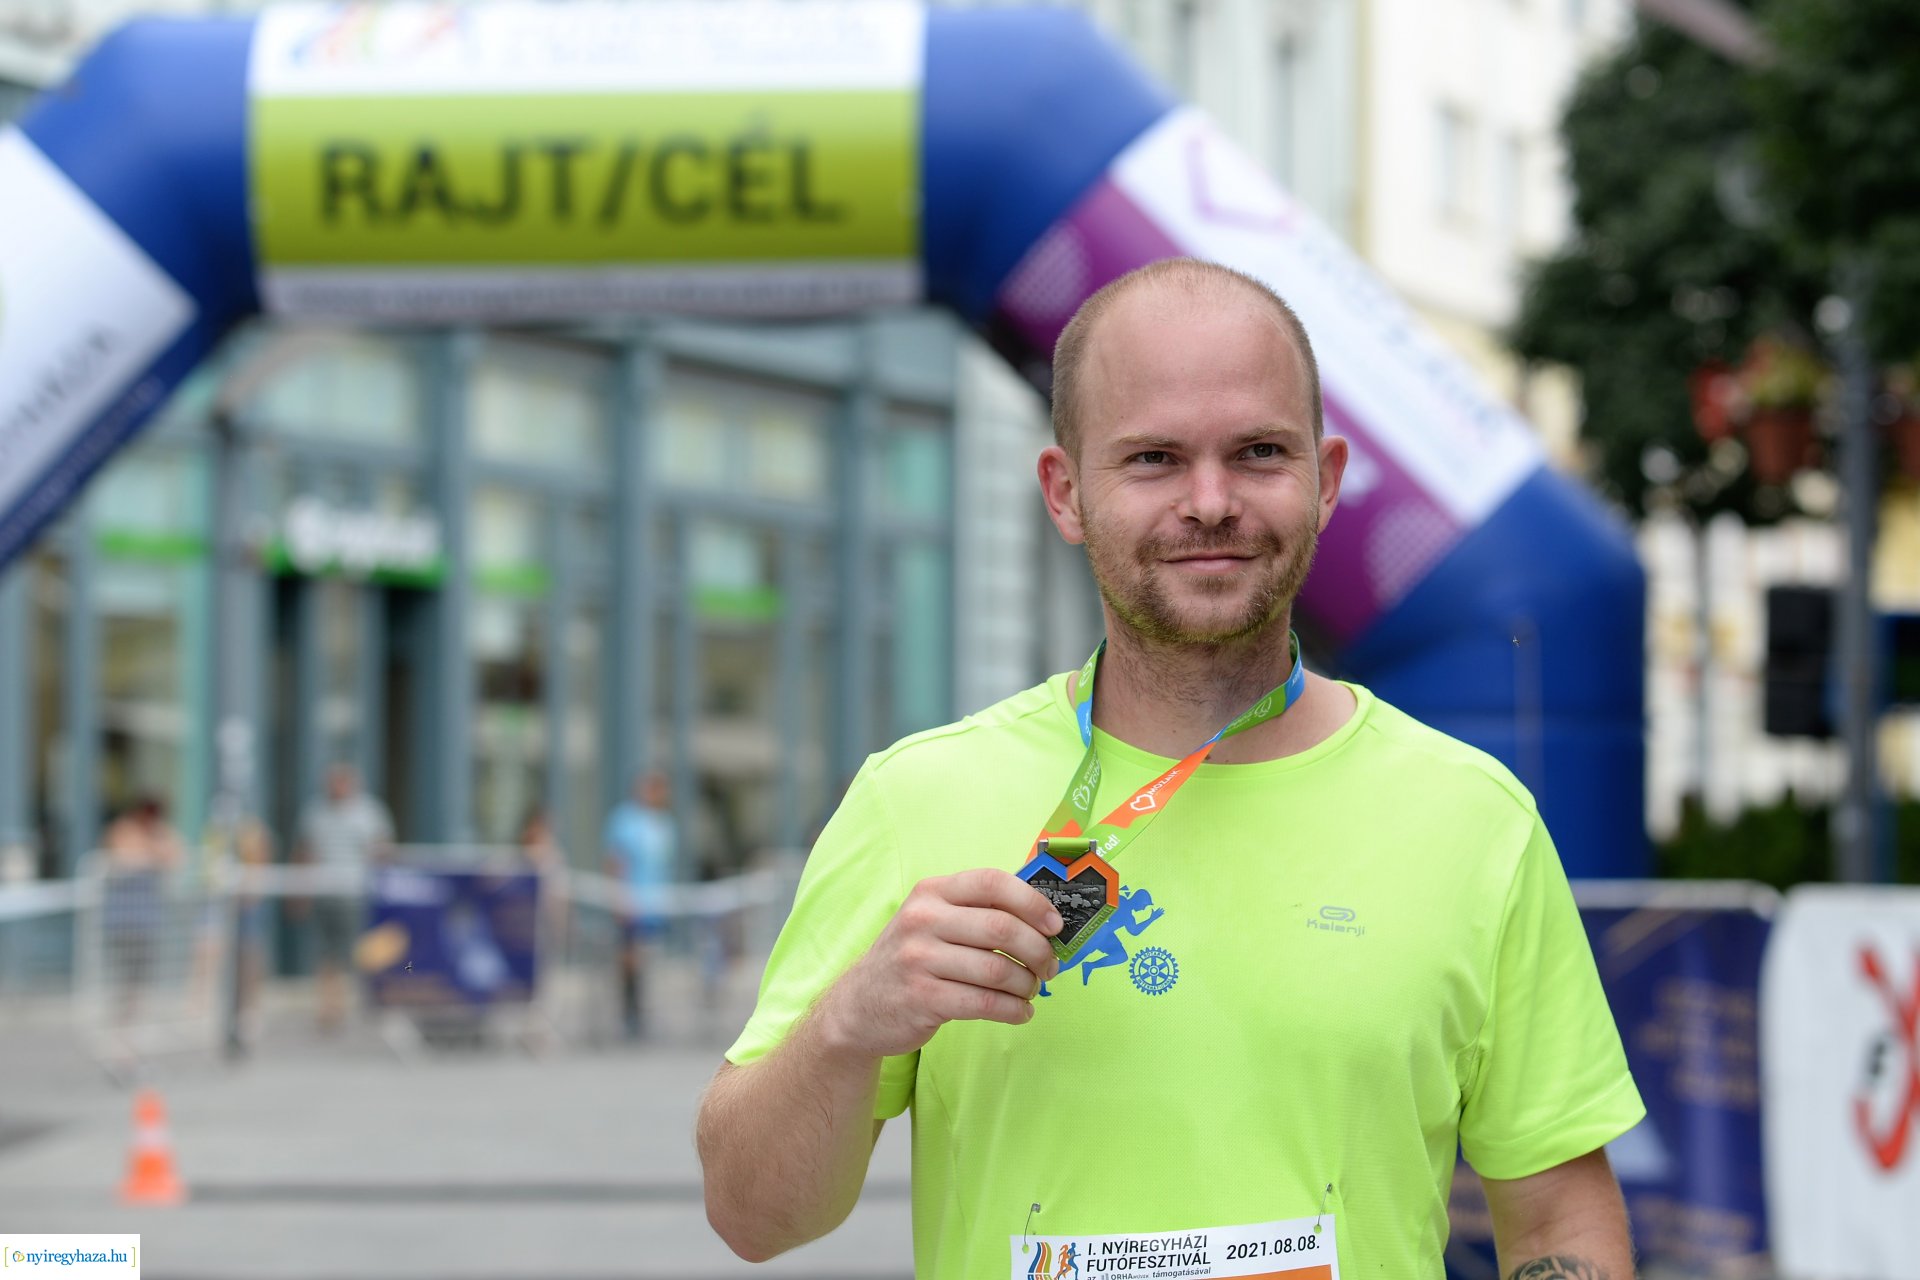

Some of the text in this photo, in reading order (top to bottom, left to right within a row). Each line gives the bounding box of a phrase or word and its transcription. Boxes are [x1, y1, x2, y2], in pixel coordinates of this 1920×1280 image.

[318, 109, 846, 229] RAJT/CÉL
[1088, 1234, 1207, 1256] I. NYÍREGYHÁZI
[1226, 1234, 1320, 1260] 2021.08.08.
[1086, 1249, 1211, 1272] FUTÓFESZTIVÁL
[1152, 1267, 1211, 1278] támogatásával
